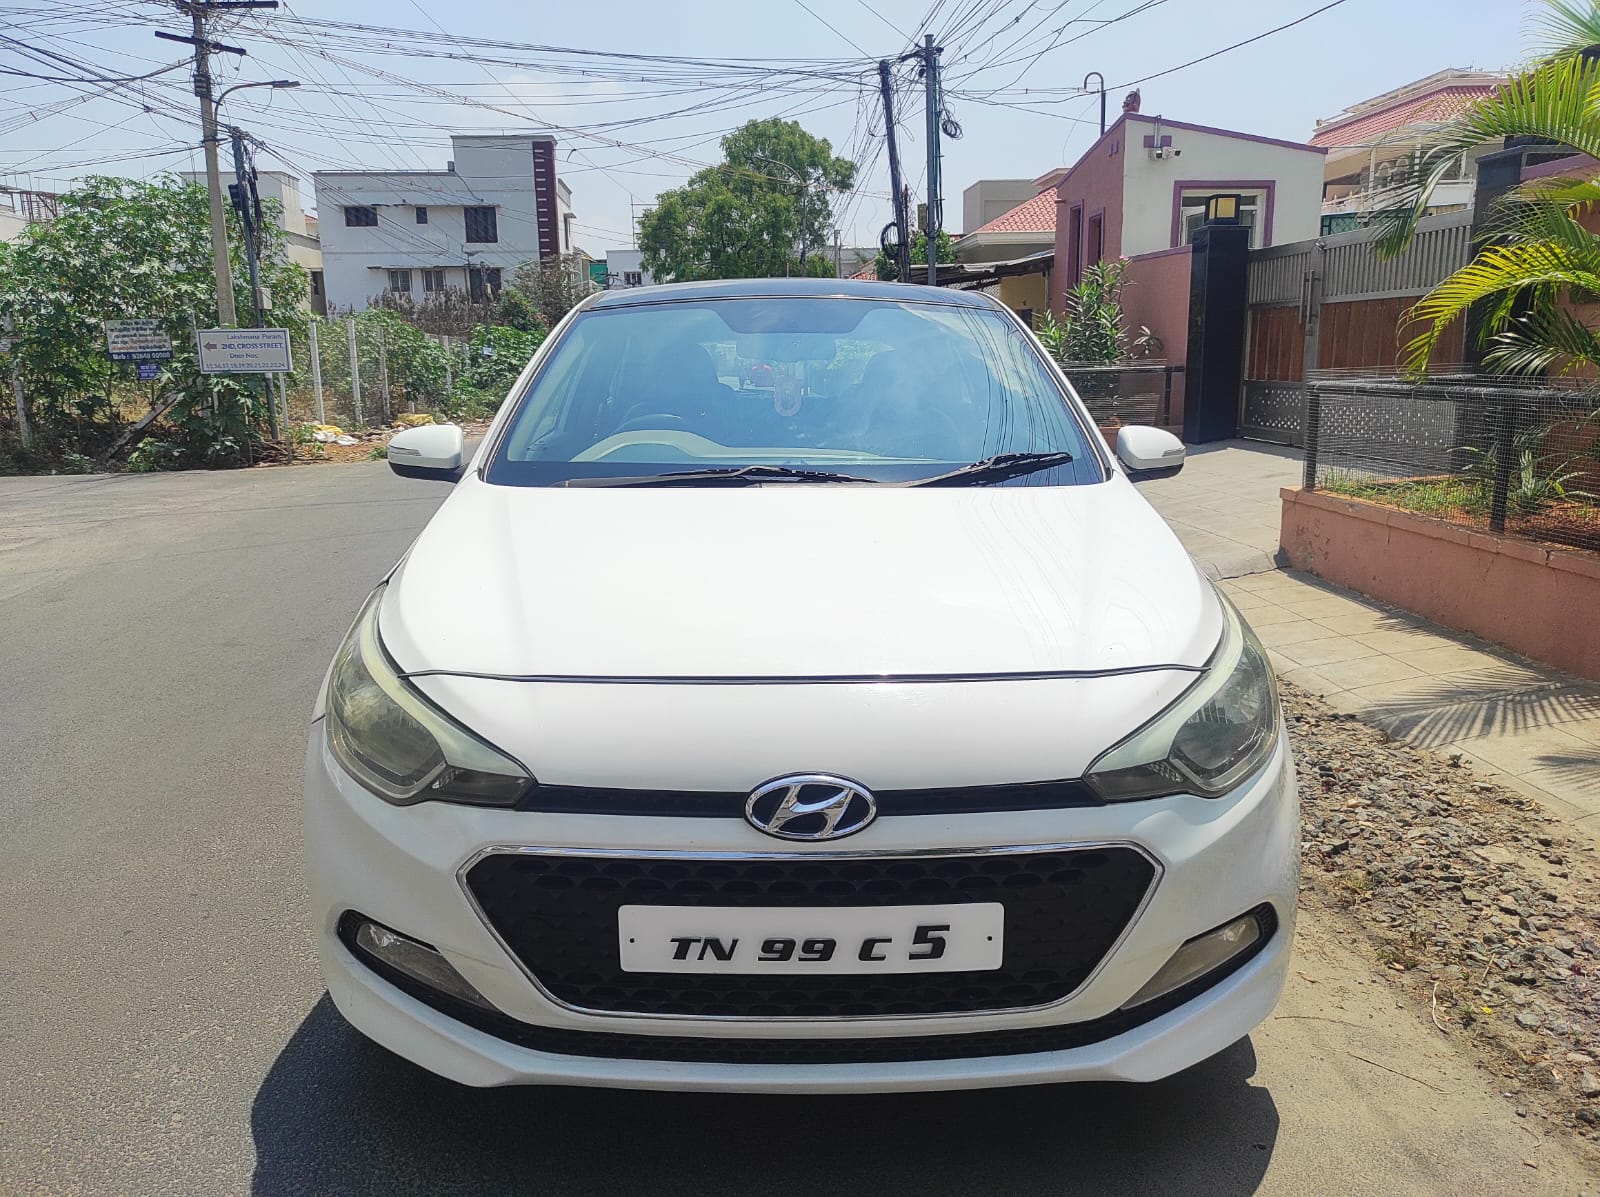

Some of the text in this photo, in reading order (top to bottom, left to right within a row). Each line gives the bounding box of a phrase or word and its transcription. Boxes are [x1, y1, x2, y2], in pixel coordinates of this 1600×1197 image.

[669, 924, 951, 962] TN 99 C 5
